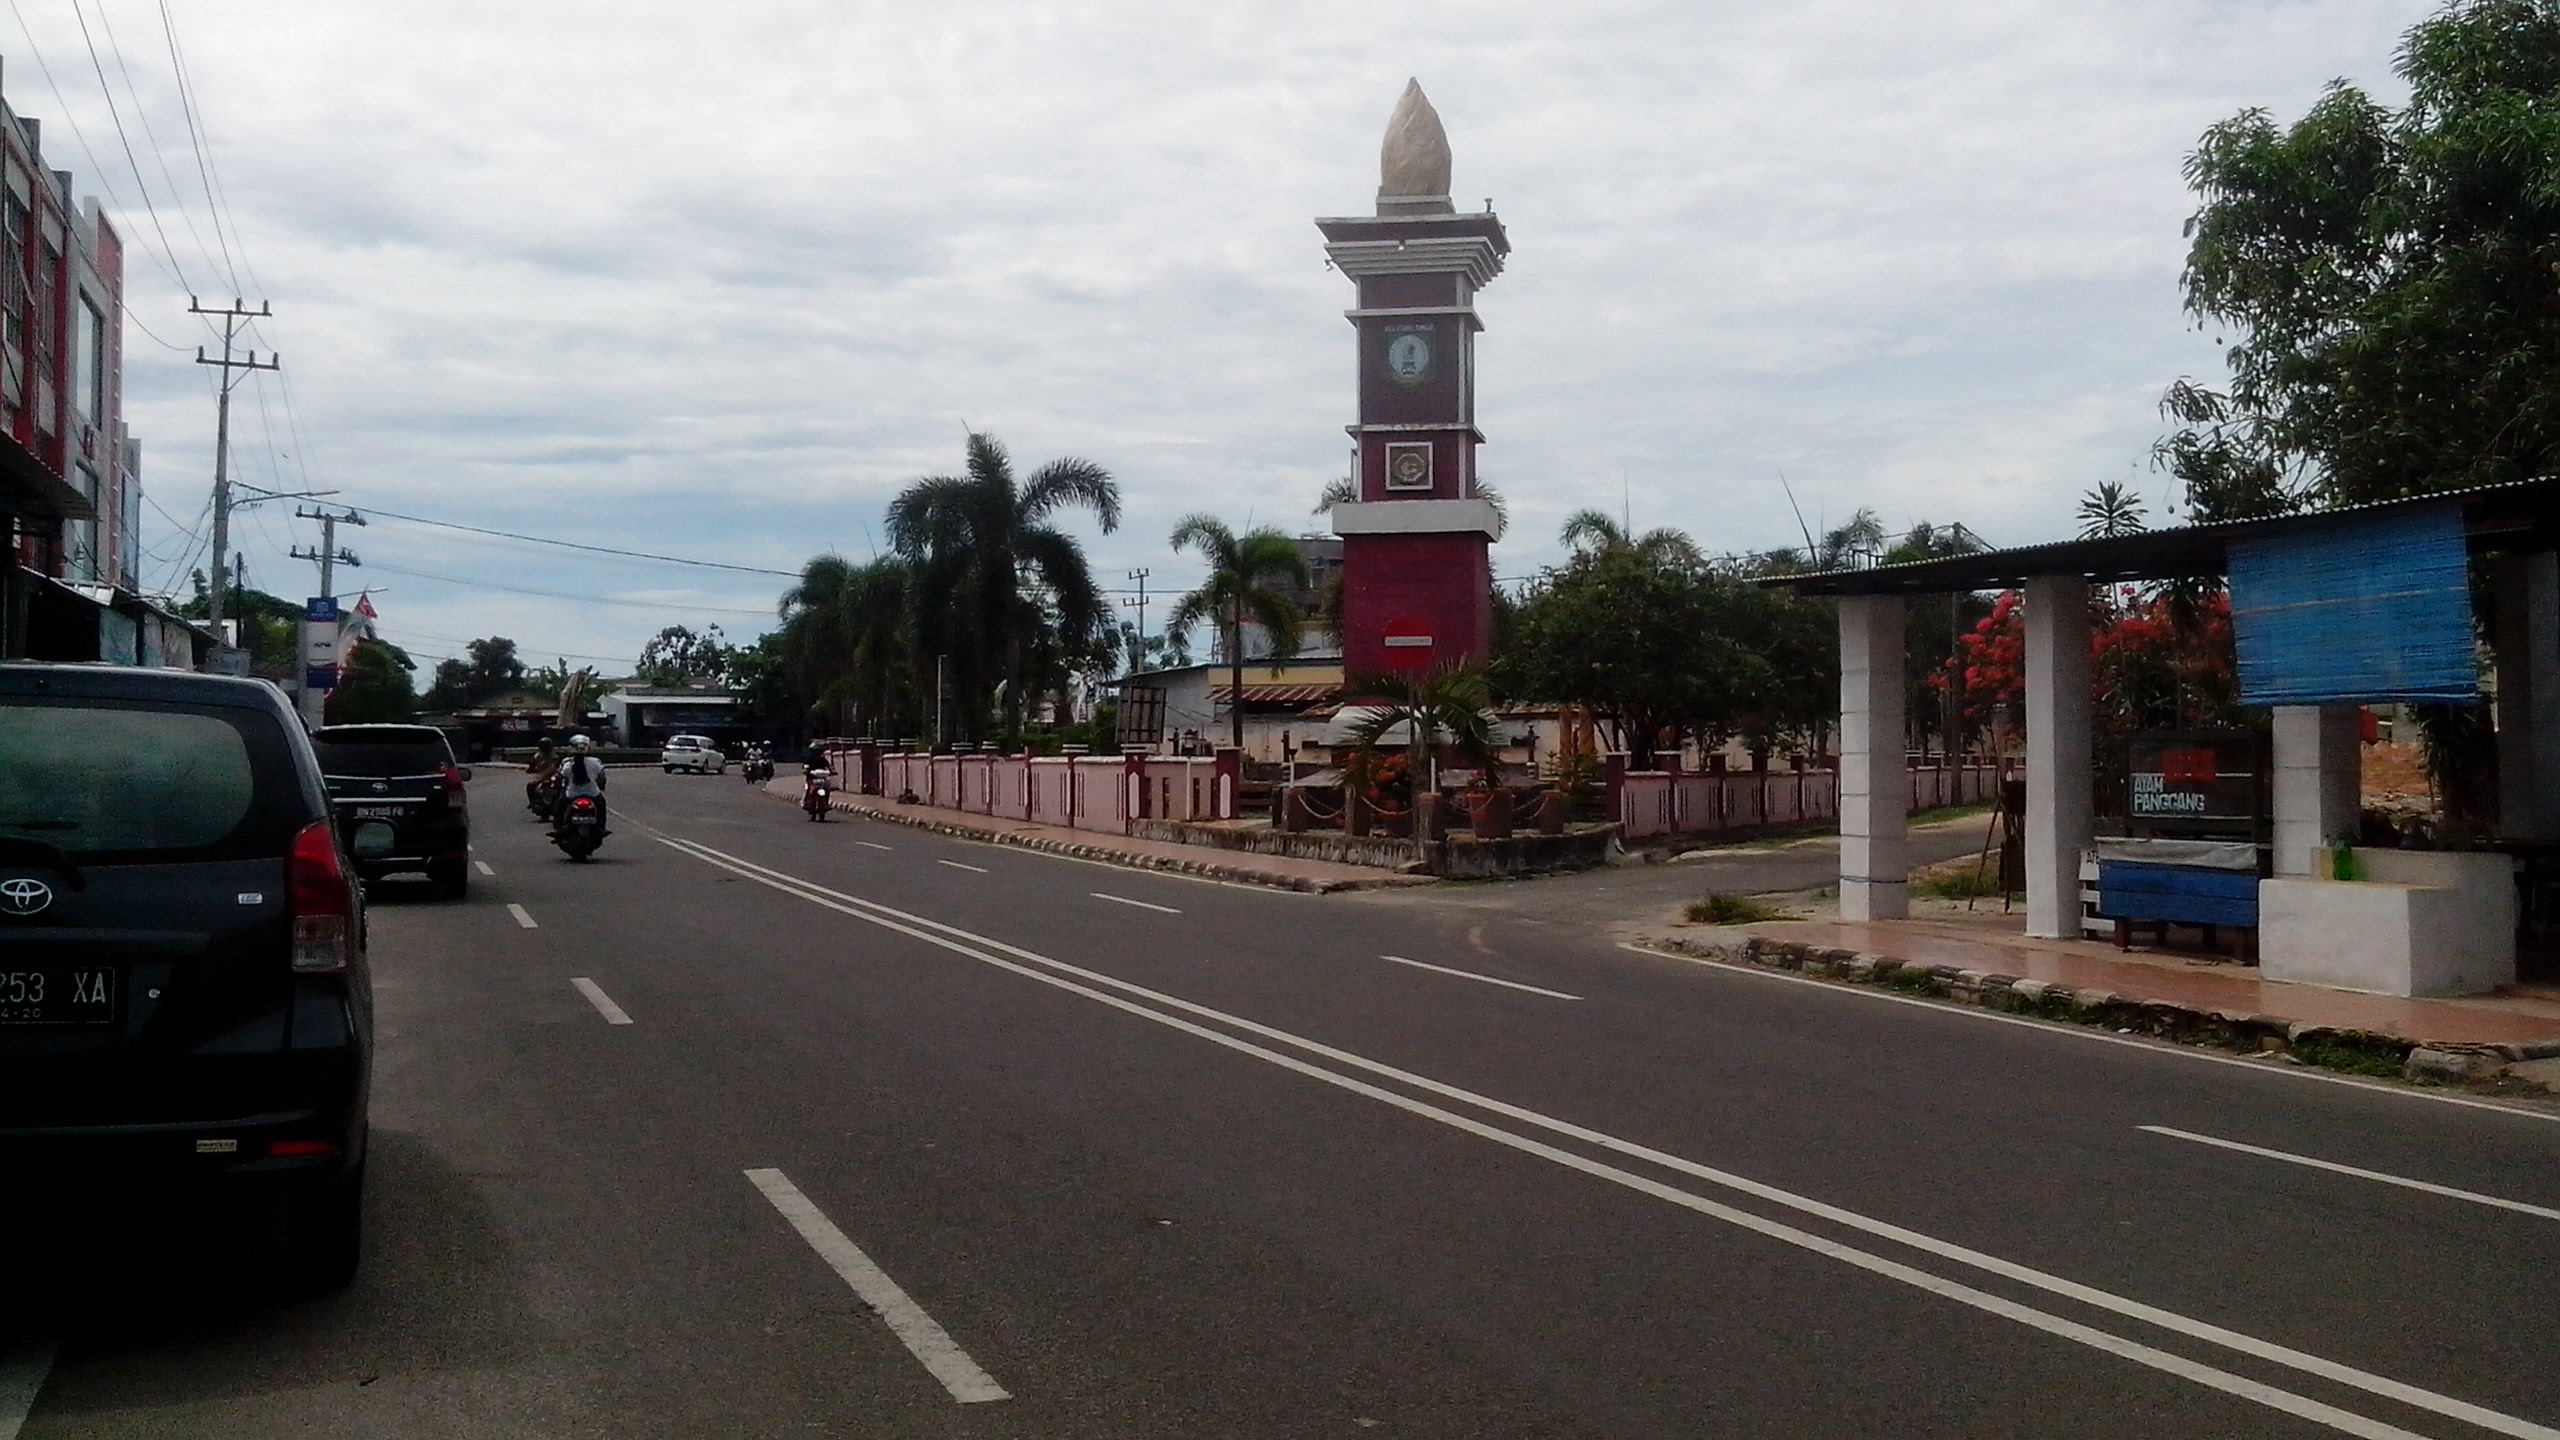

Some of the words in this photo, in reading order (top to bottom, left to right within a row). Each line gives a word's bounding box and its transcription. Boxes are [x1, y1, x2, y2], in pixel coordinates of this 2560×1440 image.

[2134, 776, 2164, 793] AYAM
[2134, 793, 2205, 812] PANGGANG
[73, 971, 106, 1003] XA
